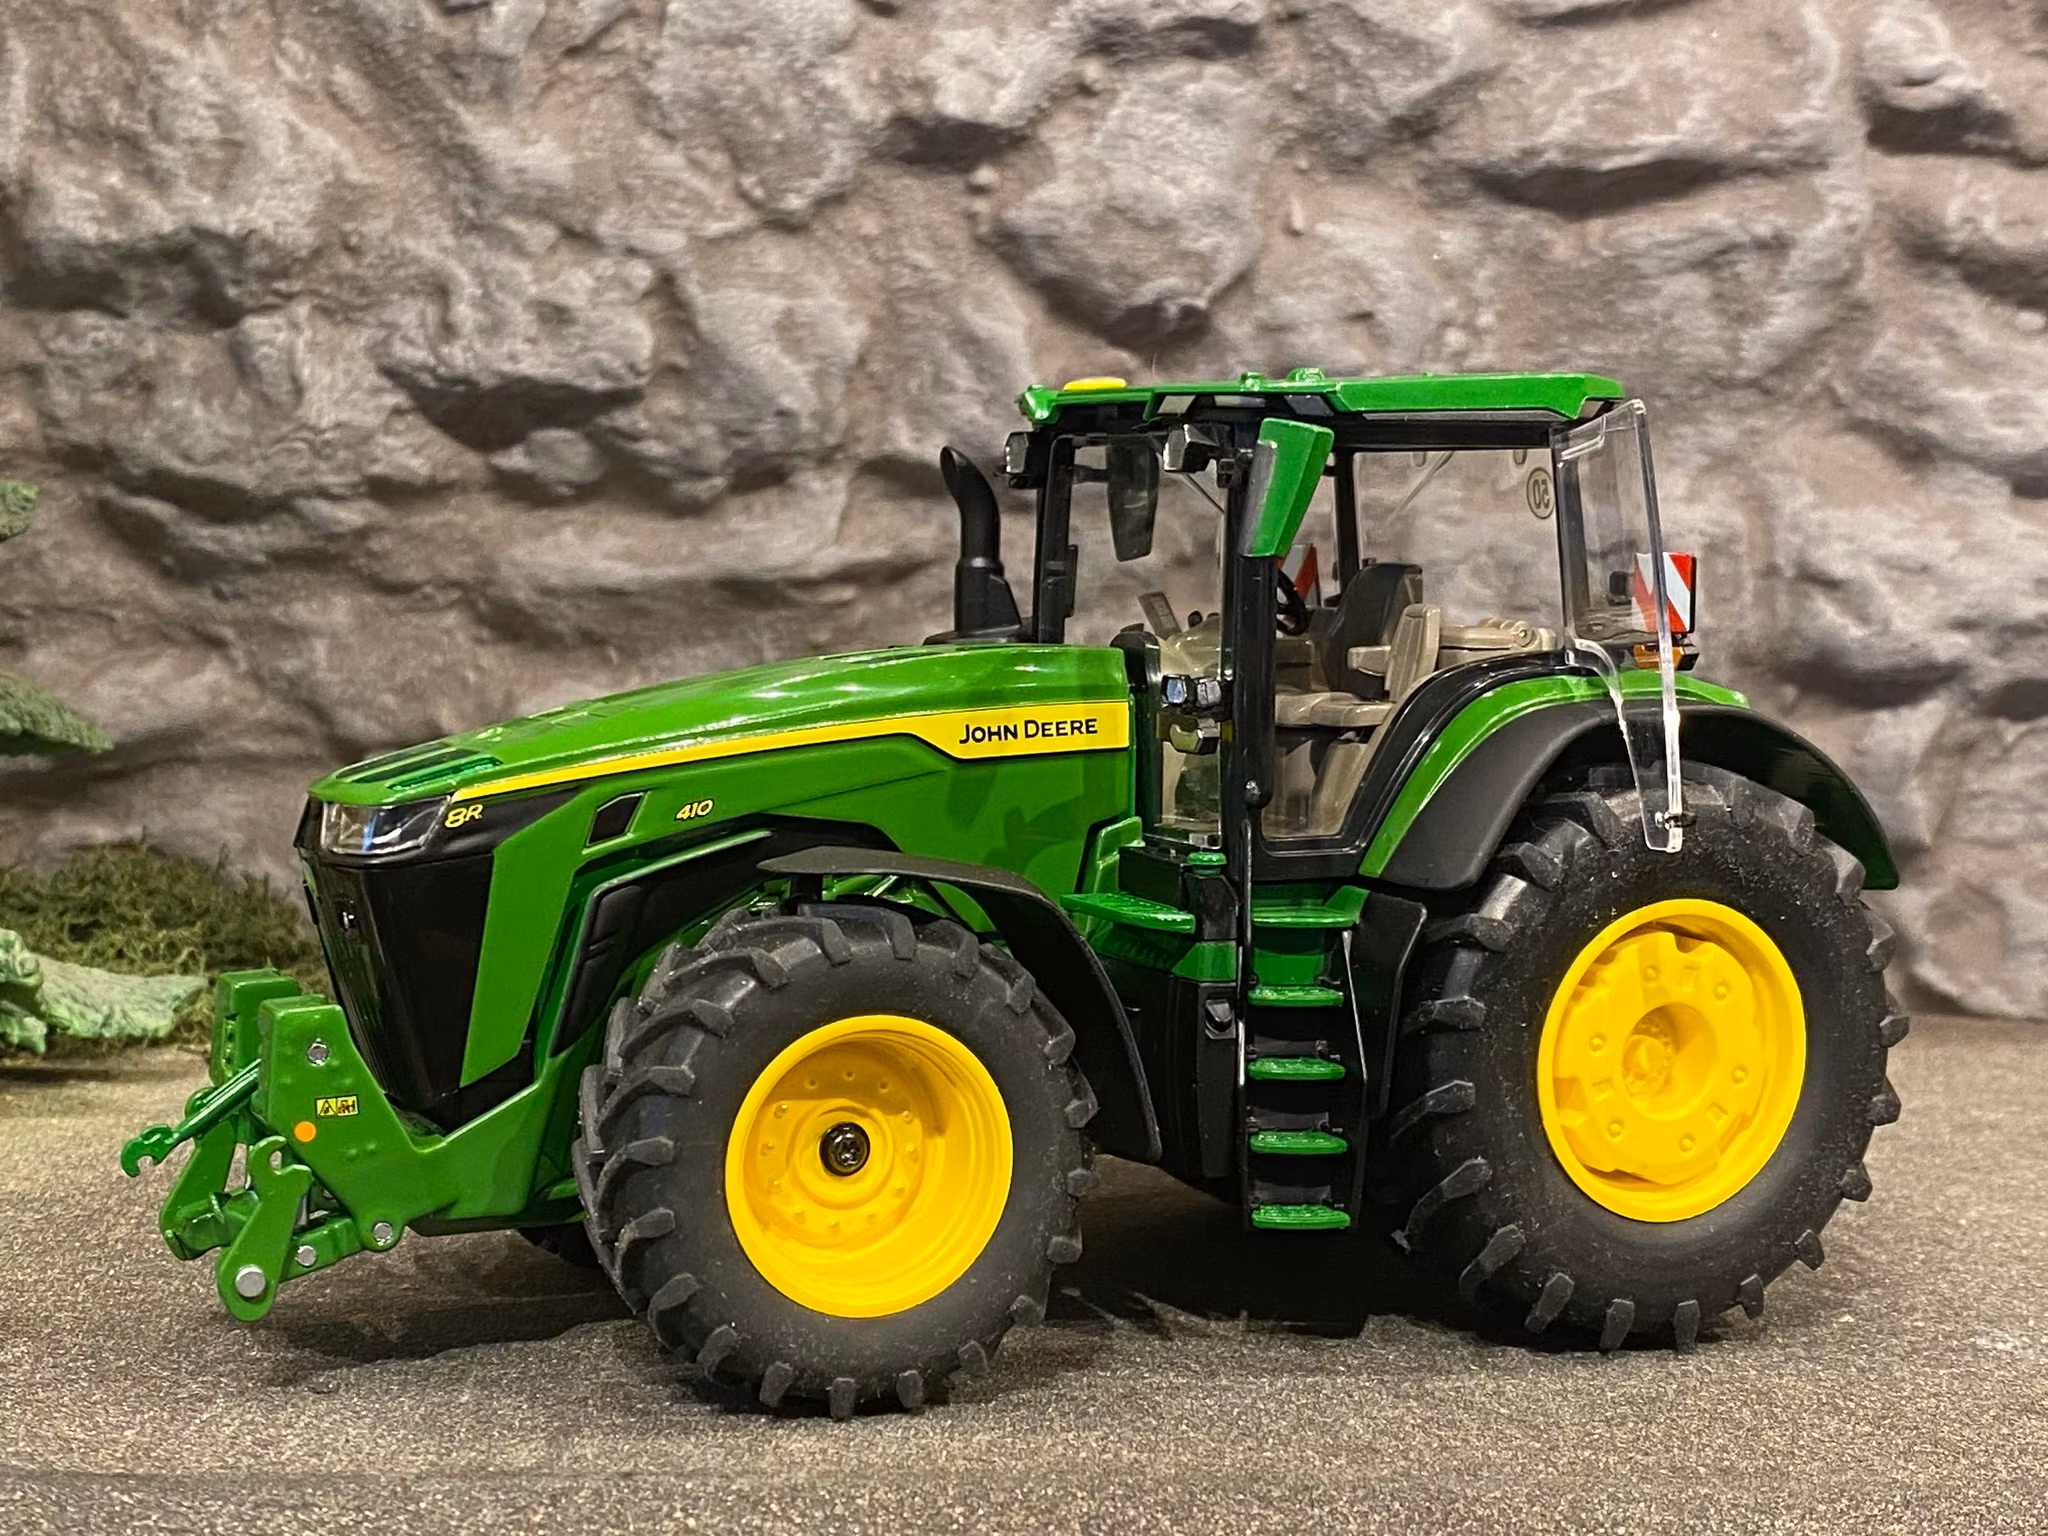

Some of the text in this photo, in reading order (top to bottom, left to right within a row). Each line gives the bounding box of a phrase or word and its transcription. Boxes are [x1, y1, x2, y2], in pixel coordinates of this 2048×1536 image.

[959, 718, 1098, 744] JOHN DEERE
[444, 804, 483, 828] 8R
[675, 799, 714, 820] 410
